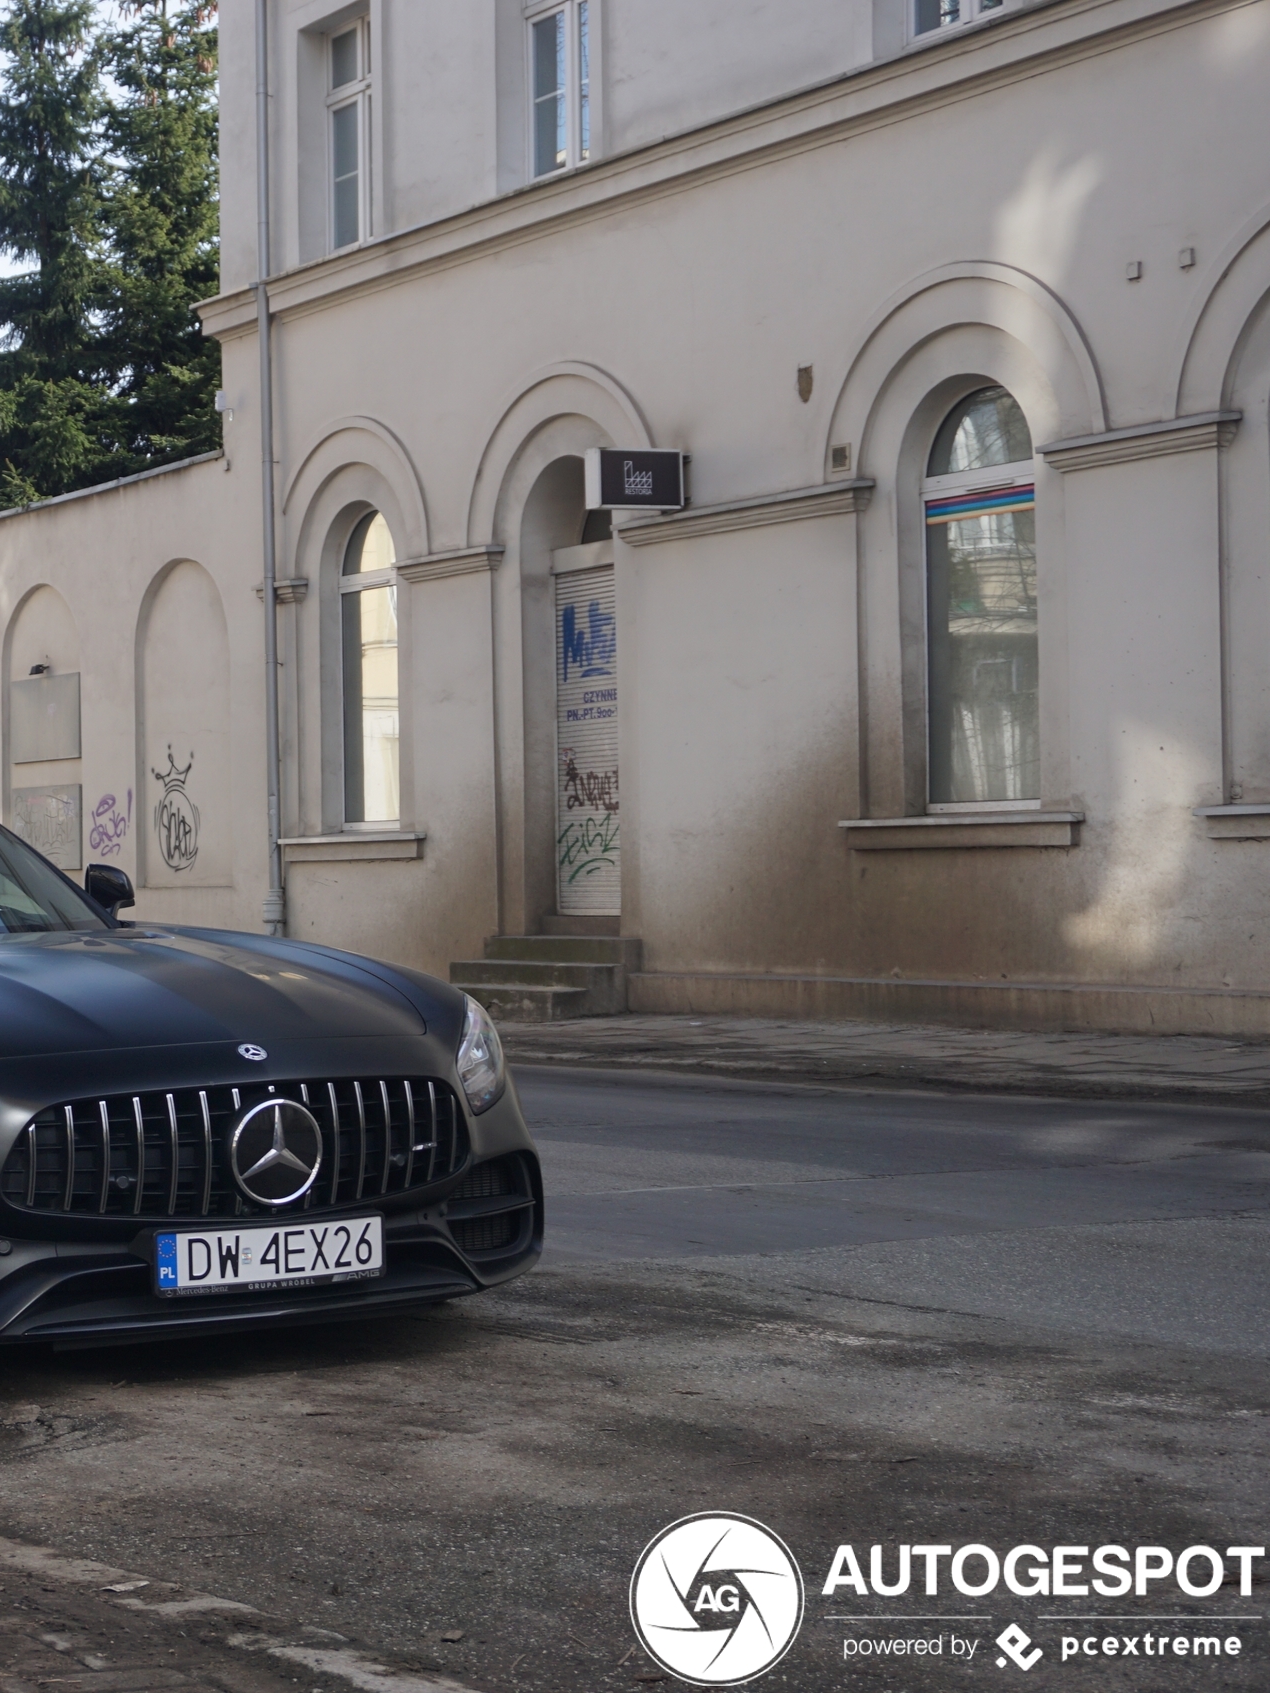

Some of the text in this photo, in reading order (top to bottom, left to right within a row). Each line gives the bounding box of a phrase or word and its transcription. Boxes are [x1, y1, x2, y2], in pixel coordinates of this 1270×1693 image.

[187, 1222, 373, 1281] DW 4EX26
[160, 1267, 175, 1279] PL
[347, 1269, 380, 1280] AMG
[176, 1285, 229, 1296] Mercedes-Benz
[248, 1282, 277, 1290] GRUPA
